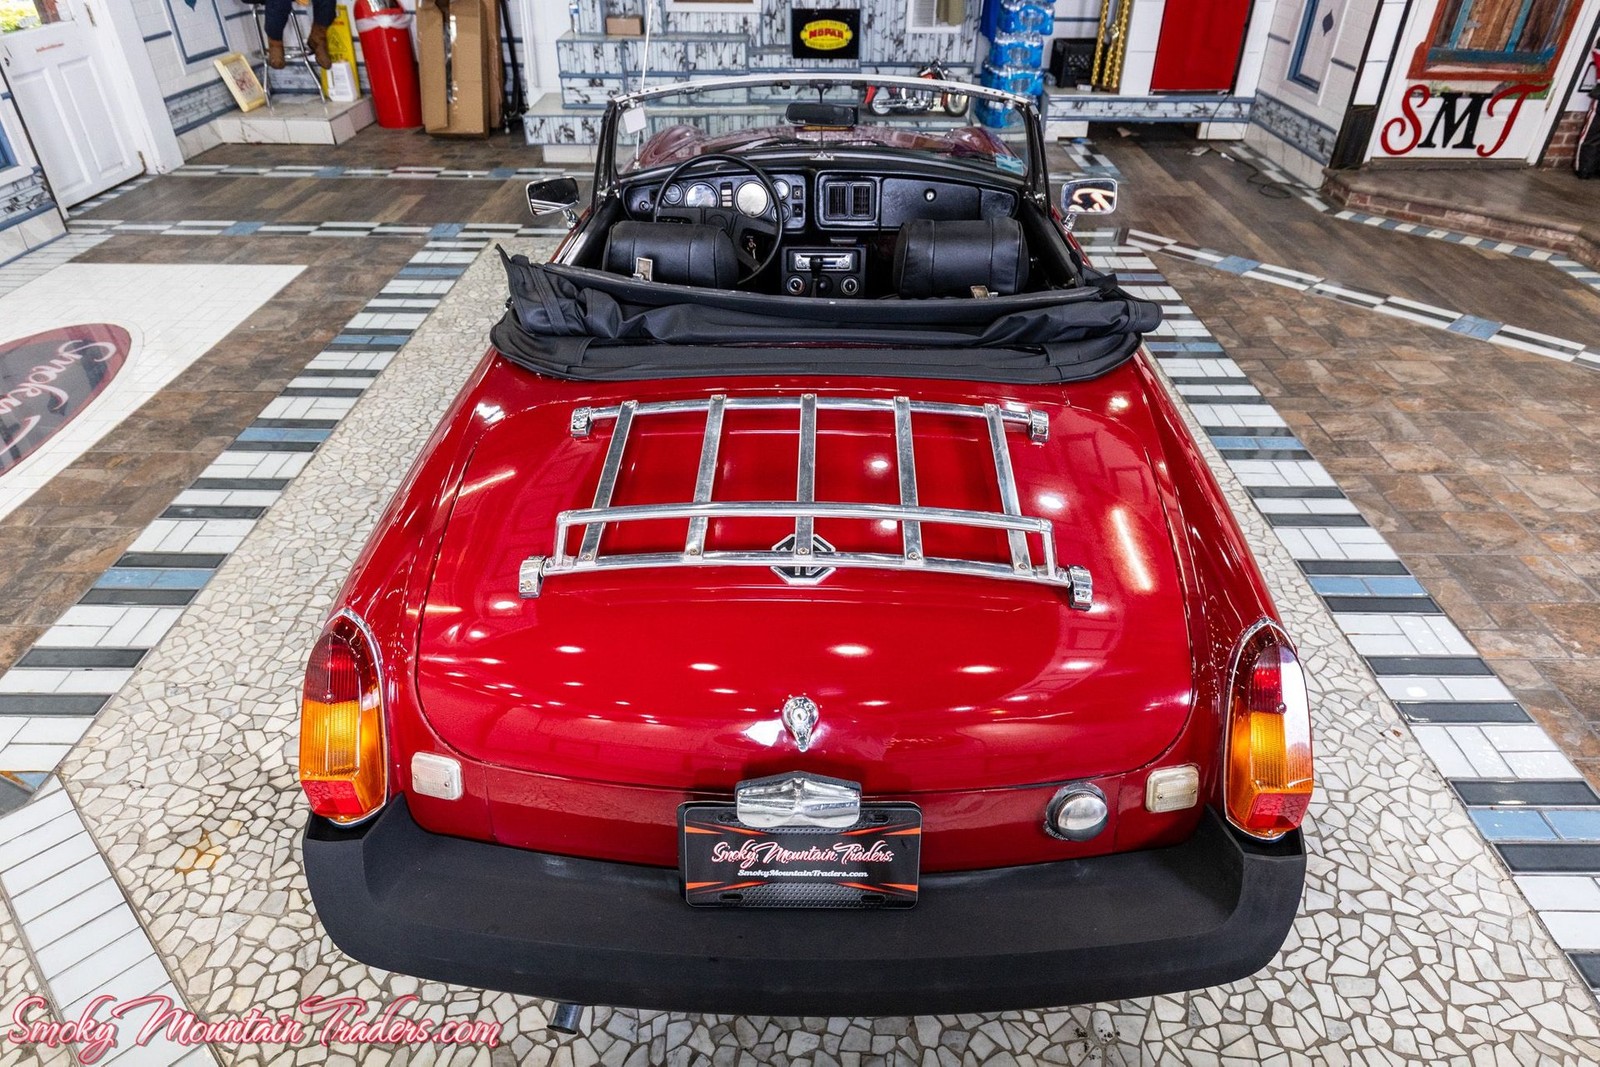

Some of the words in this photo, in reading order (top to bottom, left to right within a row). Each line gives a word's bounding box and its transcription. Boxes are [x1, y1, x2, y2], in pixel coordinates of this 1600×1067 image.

[1380, 84, 1550, 158] SMT
[711, 839, 759, 869] Smoky
[752, 841, 838, 864] Mountain
[832, 839, 894, 865] Traders
[737, 869, 868, 878] SmokyMountainTraders.com
